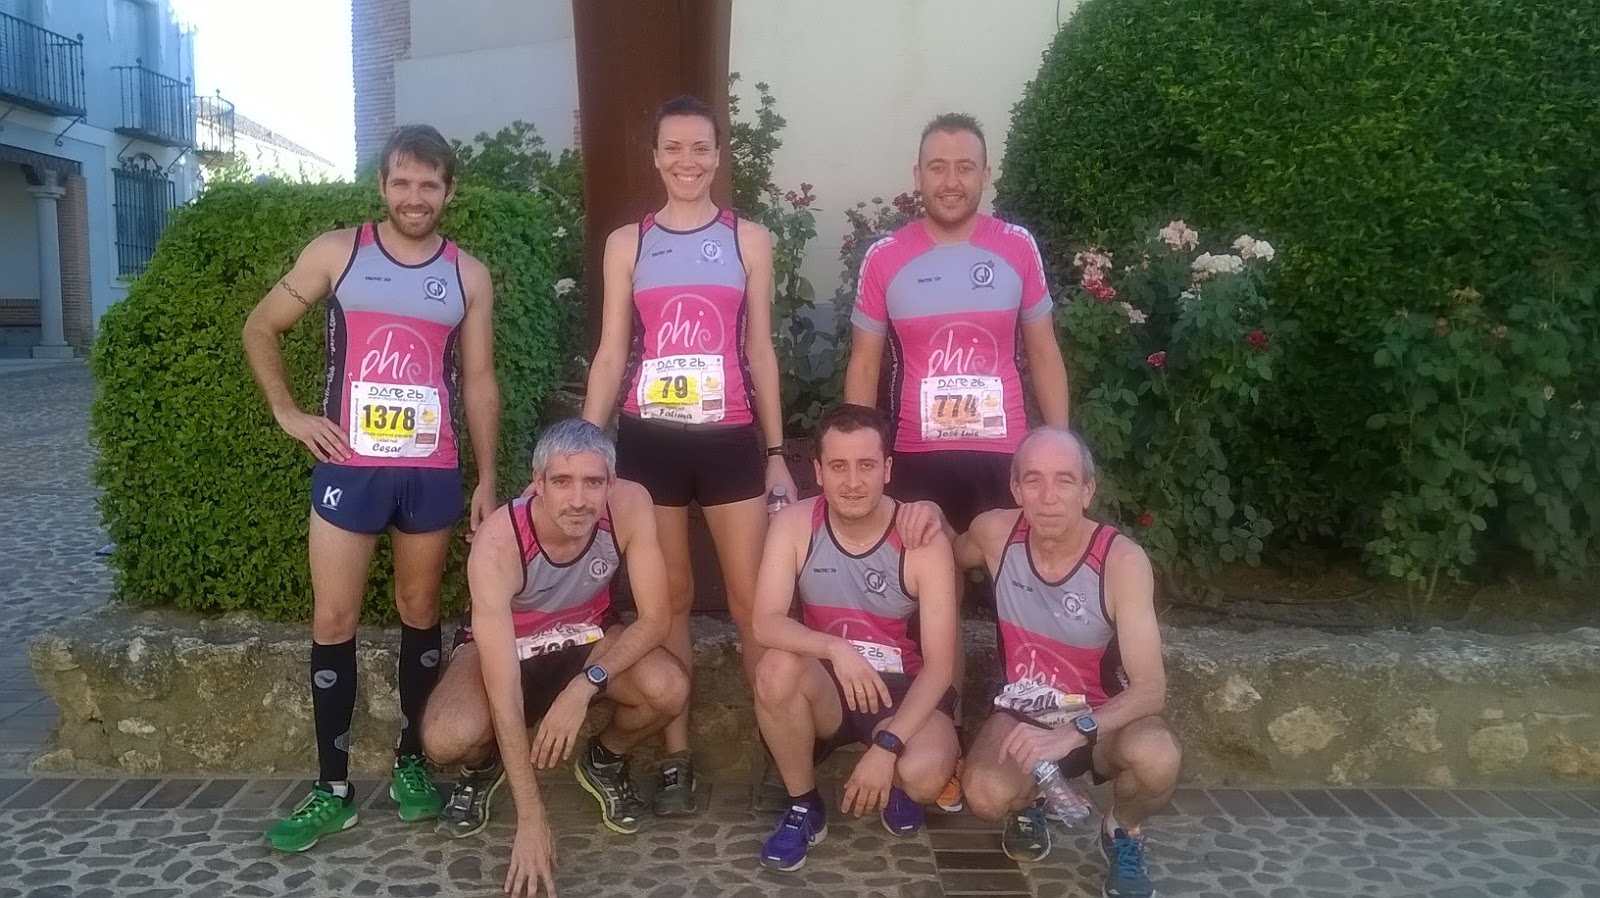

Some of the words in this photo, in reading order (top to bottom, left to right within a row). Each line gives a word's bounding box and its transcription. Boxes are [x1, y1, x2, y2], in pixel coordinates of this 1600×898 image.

[657, 301, 705, 358] phi
[360, 331, 415, 382] phi
[928, 329, 979, 377] phi
[659, 375, 688, 399] 79
[362, 404, 416, 431] 1378
[934, 394, 978, 418] 774
[960, 430, 980, 438] Luis
[372, 442, 402, 454] Cesar
